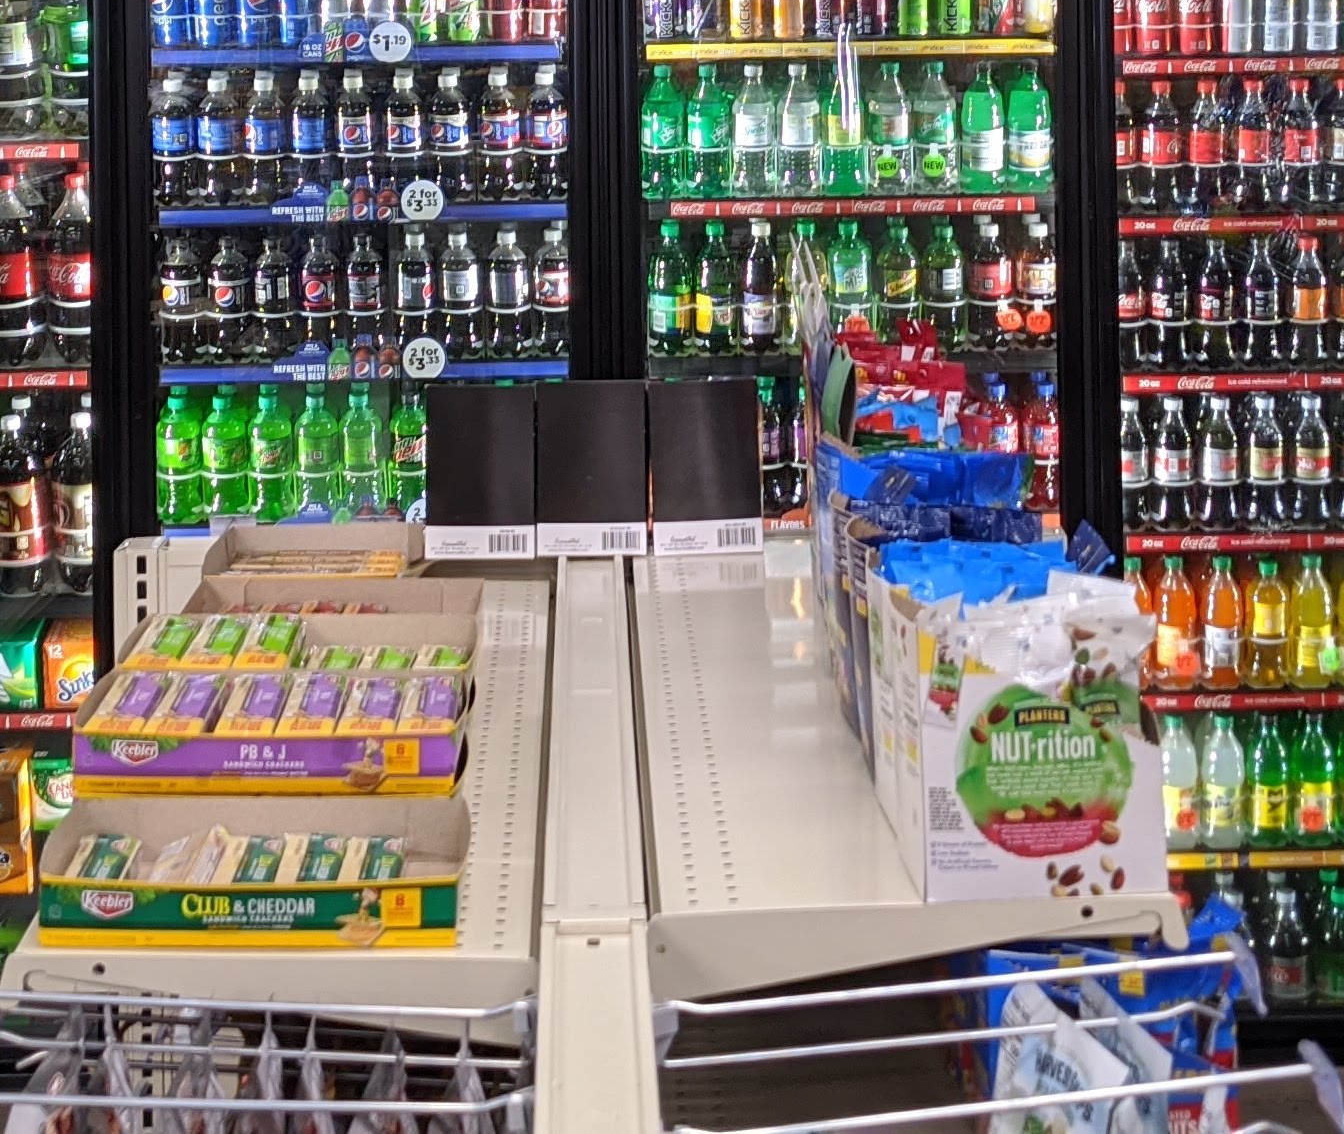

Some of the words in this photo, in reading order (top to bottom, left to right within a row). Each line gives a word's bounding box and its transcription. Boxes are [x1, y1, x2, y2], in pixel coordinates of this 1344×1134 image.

[372, 34, 407, 52] $1.19
[877, 161, 897, 171] NEW
[924, 160, 944, 170] NEW
[409, 190, 417, 198] 2
[419, 189, 438, 198] for
[272, 207, 304, 215] REFRESH
[410, 348, 418, 357] 2
[419, 347, 439, 357] for
[273, 365, 305, 374] REFRESH
[306, 364, 326, 373] WITH
[292, 373, 305, 381] THE
[306, 373, 326, 381] BEST
[49, 643, 62, 657] 12
[57, 673, 94, 703] Sunk
[112, 742, 159, 759] Keebler
[240, 744, 258, 759] PB
[262, 744, 274, 759] &
[277, 744, 287, 759] J
[83, 891, 133, 910] Keebler
[181, 892, 231, 918] CLUB
[233, 900, 244, 914] &
[247, 898, 316, 916] CHEDDAR
